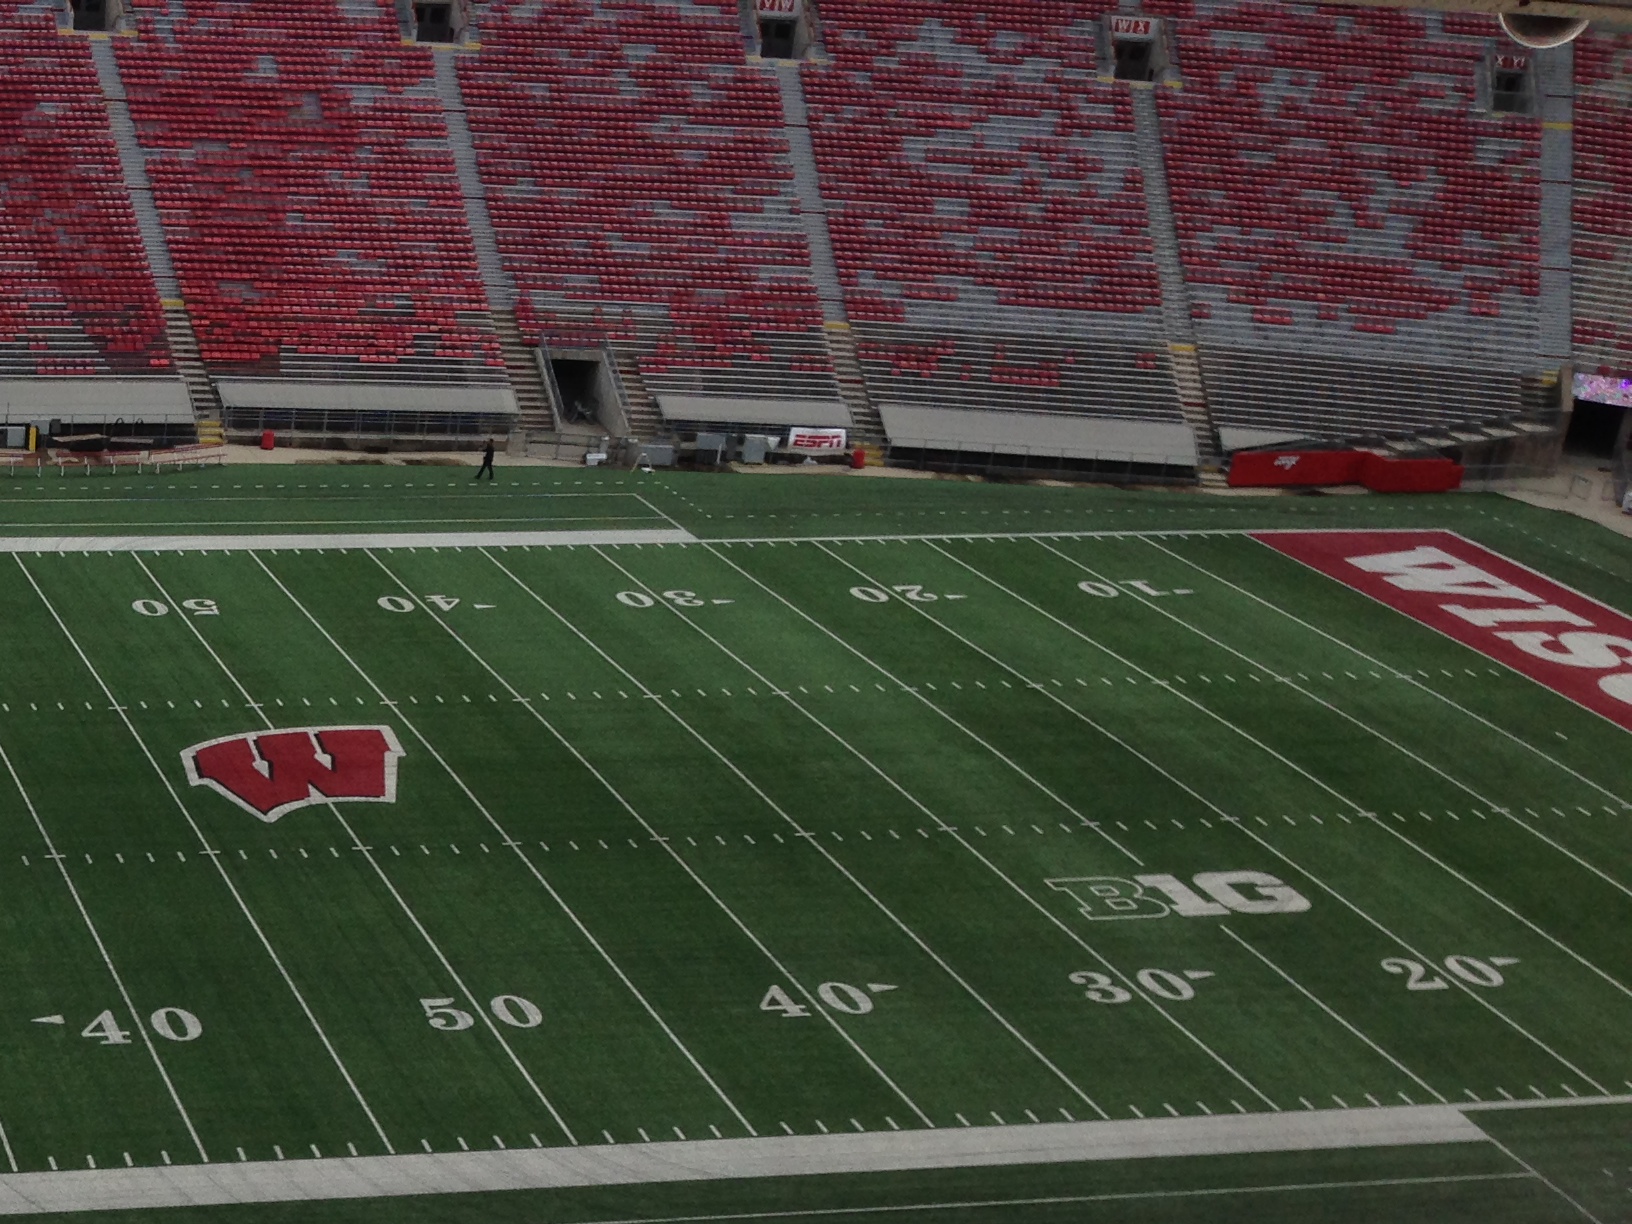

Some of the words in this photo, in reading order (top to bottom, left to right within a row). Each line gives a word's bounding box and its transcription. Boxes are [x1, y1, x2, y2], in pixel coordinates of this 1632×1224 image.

[793, 434, 842, 448] ESPN
[616, 589, 706, 609] 30
[849, 584, 939, 603] 20
[1076, 579, 1171, 598] 10
[131, 598, 220, 616] 50
[377, 595, 460, 613] 40
[1344, 546, 1632, 706] WIS
[1069, 968, 1196, 1004] 30
[1380, 955, 1505, 991] 20
[419, 995, 543, 1031] 50
[759, 981, 874, 1018] 40
[80, 1007, 204, 1045] 40
